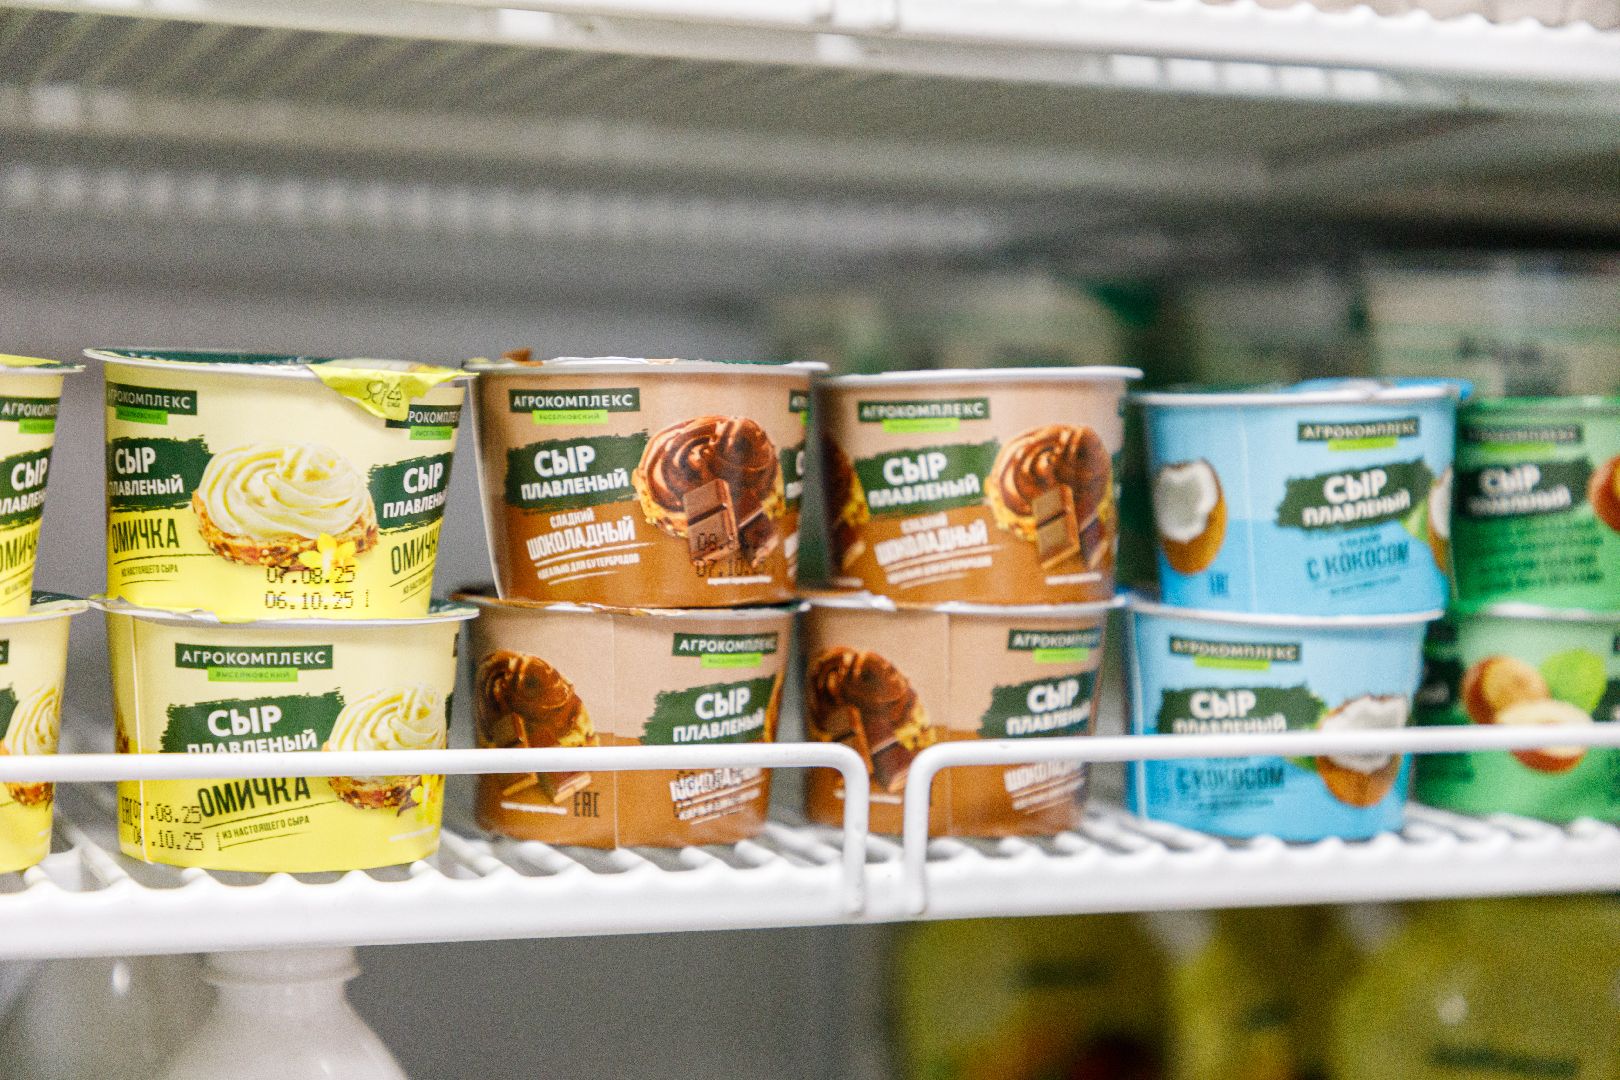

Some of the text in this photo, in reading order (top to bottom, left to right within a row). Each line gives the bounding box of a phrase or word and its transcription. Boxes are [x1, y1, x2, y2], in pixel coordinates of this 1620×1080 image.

[513, 394, 633, 409] АГРОКОМПЛЕКС
[11, 457, 47, 491] СЫР
[114, 447, 156, 474] СЫР
[534, 446, 596, 477] СЫР
[883, 453, 948, 485] СЫР
[403, 463, 443, 494] СЫР
[520, 469, 630, 500] ПЛАВЛЕНЫЙ
[868, 473, 980, 507] ПЛАВЛЕНЫЙ
[1324, 469, 1387, 504] СЫР
[1302, 489, 1411, 527] ПЛАВЛЕНЫЙ
[112, 518, 179, 553] ОМИЧКА
[526, 515, 636, 560] ШОКОЛАДНЫЙ
[266, 565, 356, 585] 07.08.25
[265, 590, 354, 610] 06.10.25
[182, 650, 326, 667] АГРОКОМПЛЕКС
[695, 687, 751, 720] СЫР
[1027, 679, 1080, 714] СЫР
[1189, 690, 1257, 719] СЫР
[207, 705, 282, 737] СЫР
[673, 706, 765, 742] ПЛАВЛЕНЫЙ
[197, 777, 311, 817] ОМИЧКА
[222, 815, 310, 840] ИЗ НАСТОЯЩЕГО СЫРА
